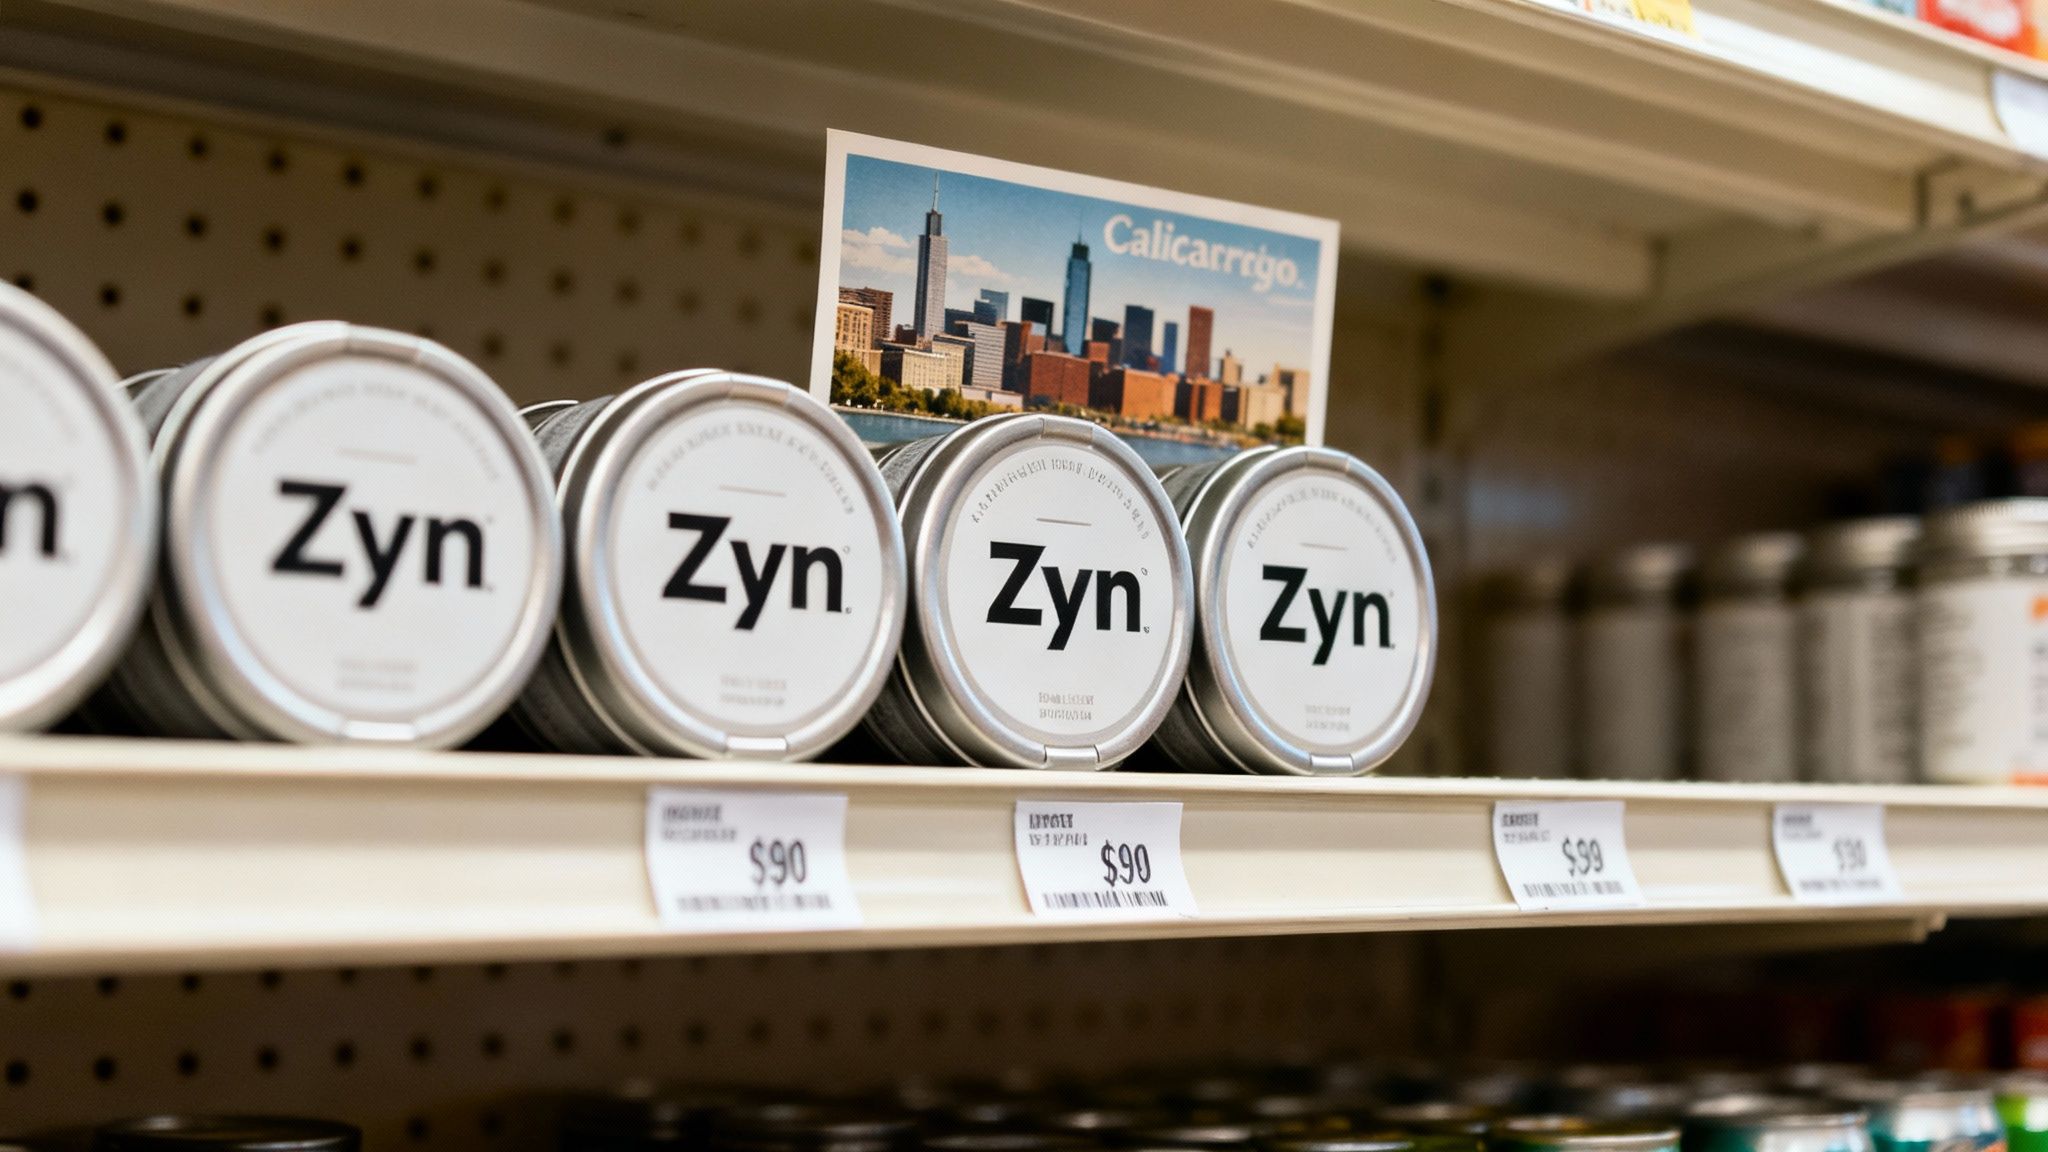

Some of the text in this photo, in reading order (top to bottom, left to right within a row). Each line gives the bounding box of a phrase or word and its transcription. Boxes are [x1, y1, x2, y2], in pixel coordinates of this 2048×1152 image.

[271, 479, 484, 609] Zyn
[662, 512, 844, 631] Zyn
[986, 540, 1141, 651] Zyn
[1259, 564, 1391, 666] Zyn
[749, 836, 807, 886] $90
[1100, 839, 1152, 888] $90
